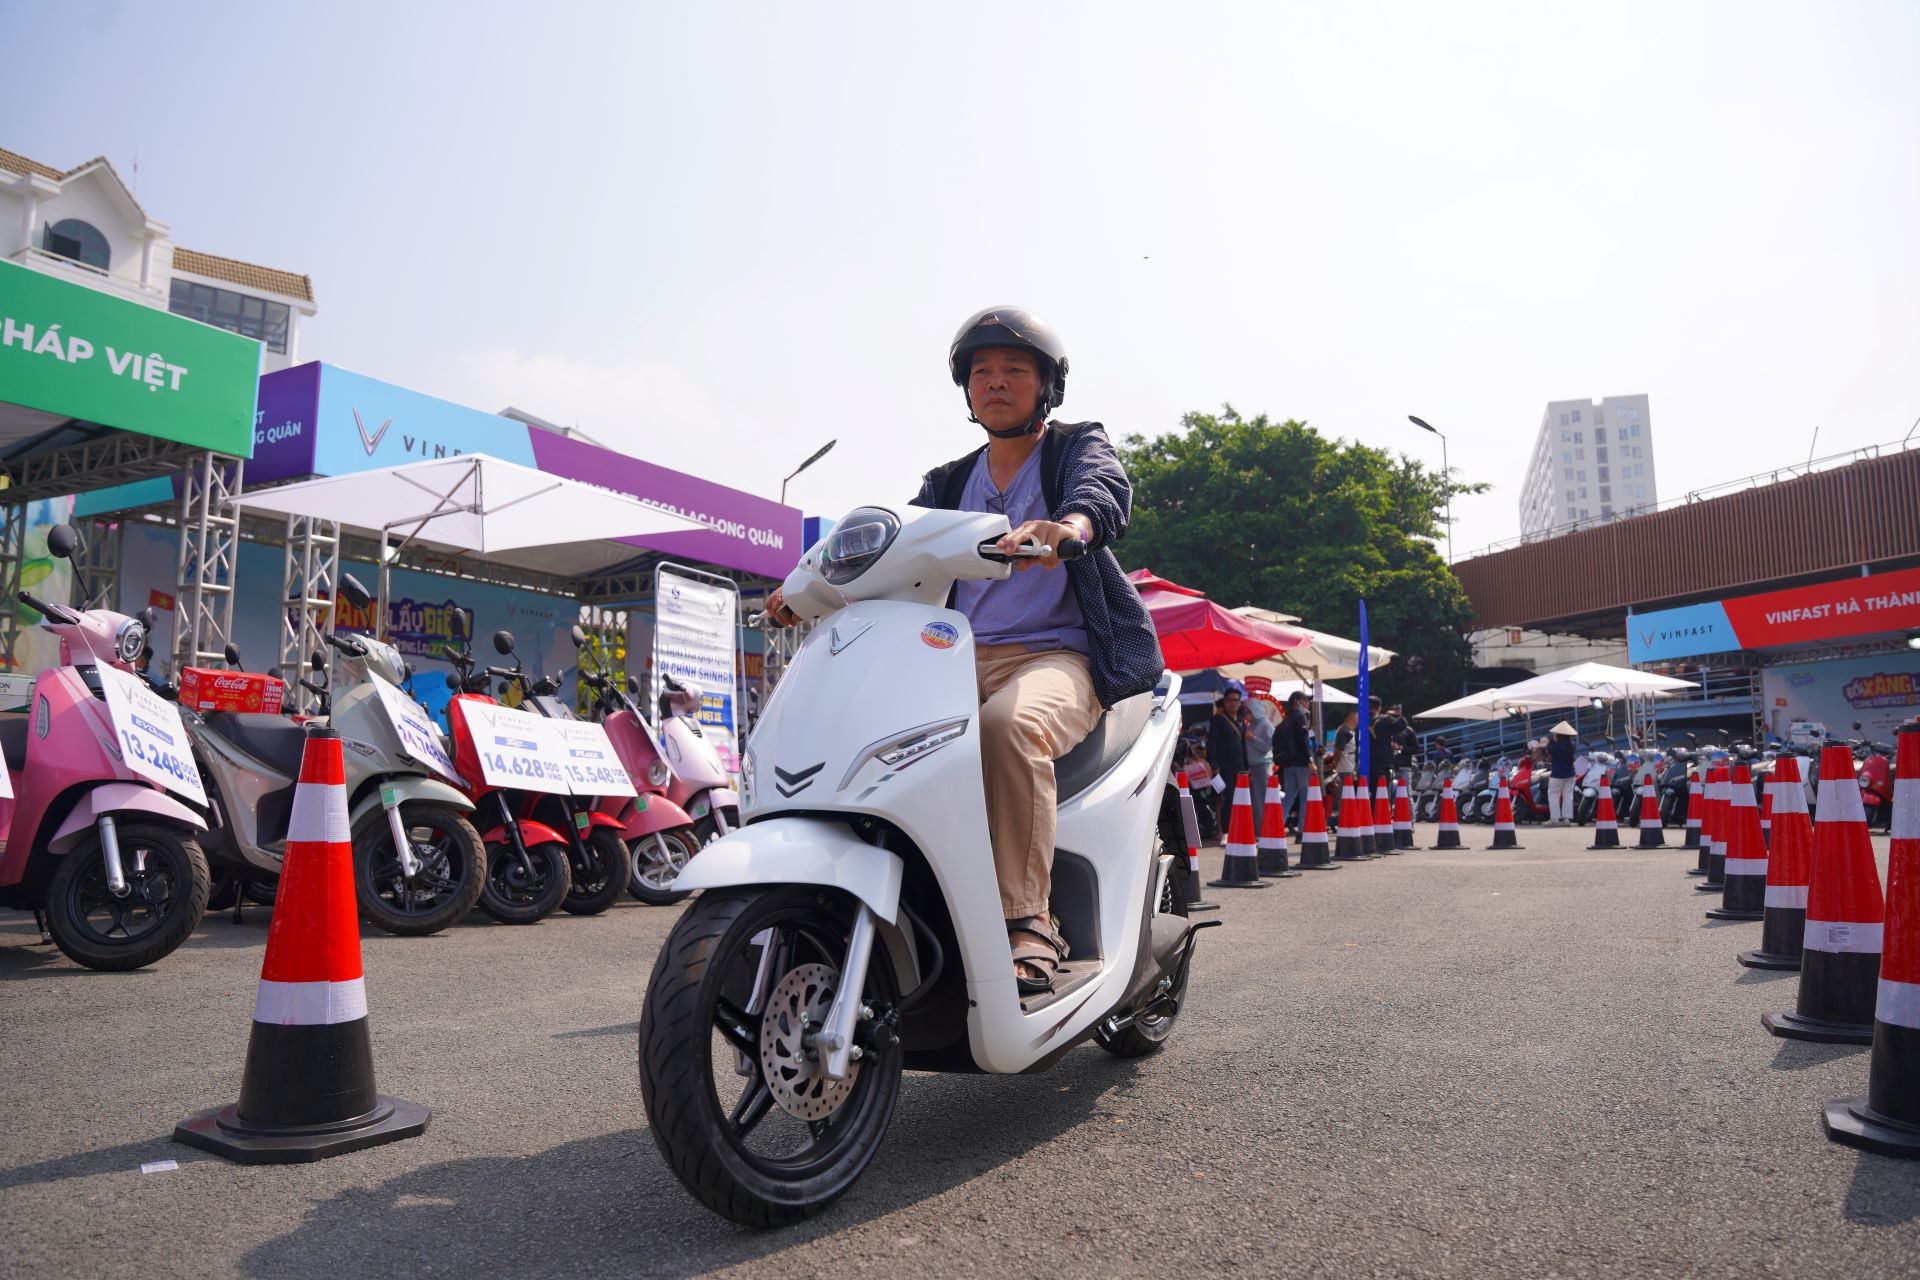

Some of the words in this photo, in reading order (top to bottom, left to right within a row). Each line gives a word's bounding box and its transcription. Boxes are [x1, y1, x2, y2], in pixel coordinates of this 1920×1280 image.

[0, 317, 94, 364] HÁP
[105, 346, 188, 392] VIỆT
[267, 420, 302, 443] QUÂN
[748, 528, 784, 550] QUÂN
[1765, 603, 1832, 625] VINFAST
[1836, 597, 1861, 615] HÀ
[1661, 624, 1713, 640] VINFAST
[121, 729, 184, 780] 13.248
[484, 752, 545, 779] 14.628
[564, 764, 613, 785] 15.548
